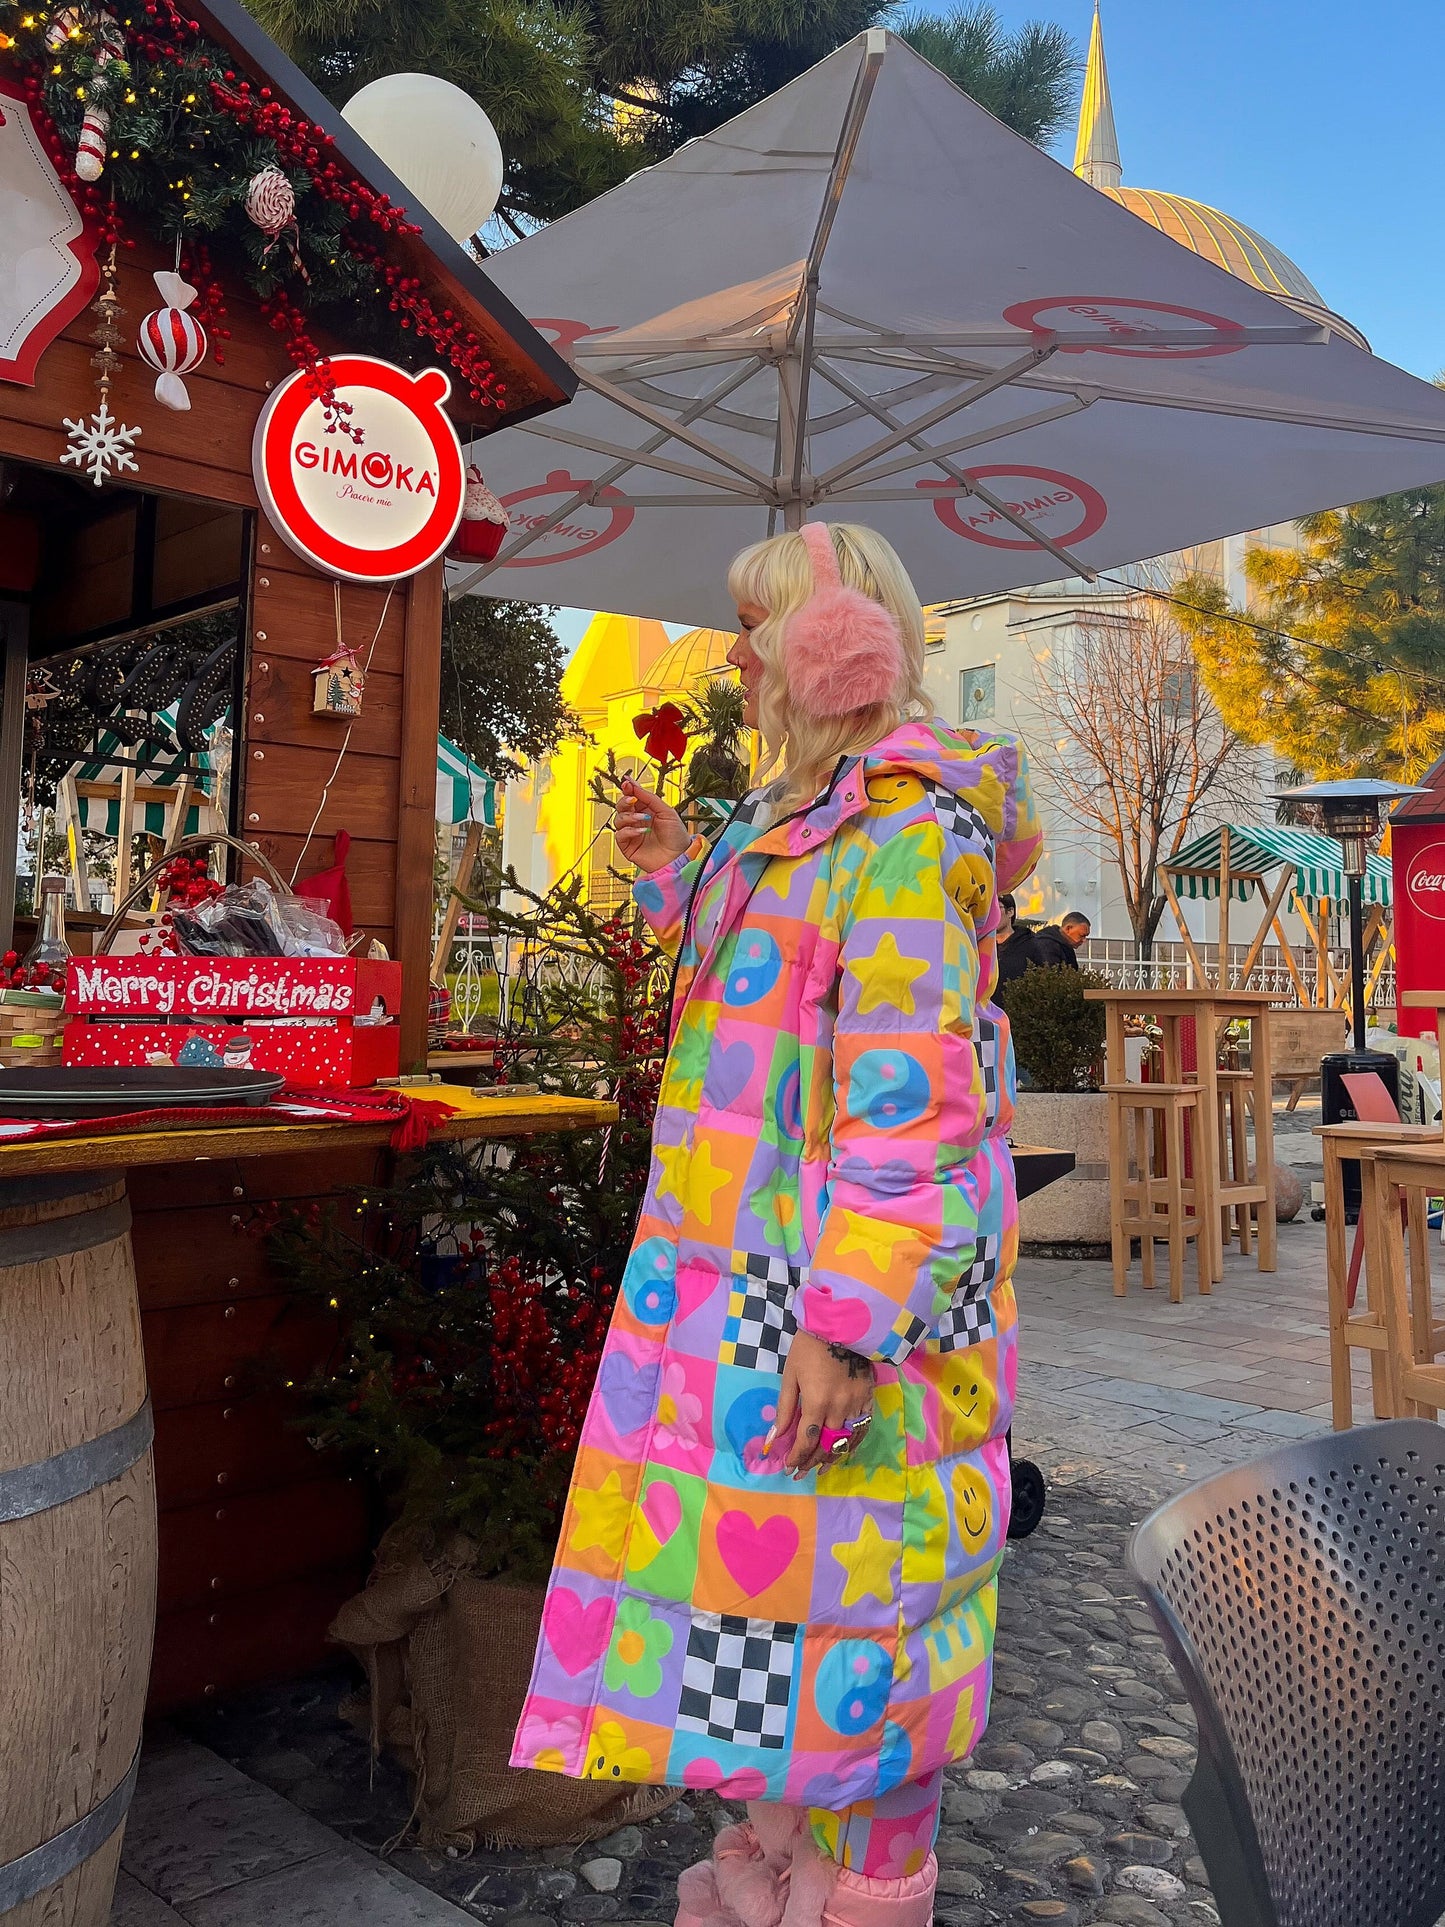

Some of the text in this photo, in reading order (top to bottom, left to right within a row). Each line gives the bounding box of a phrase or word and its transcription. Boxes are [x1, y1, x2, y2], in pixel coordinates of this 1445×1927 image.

[295, 442, 436, 497] GIMOKA
[336, 484, 392, 507] Piacere mio
[1411, 870, 1445, 892] Coca
[76, 966, 352, 1012] Merry Christmas
